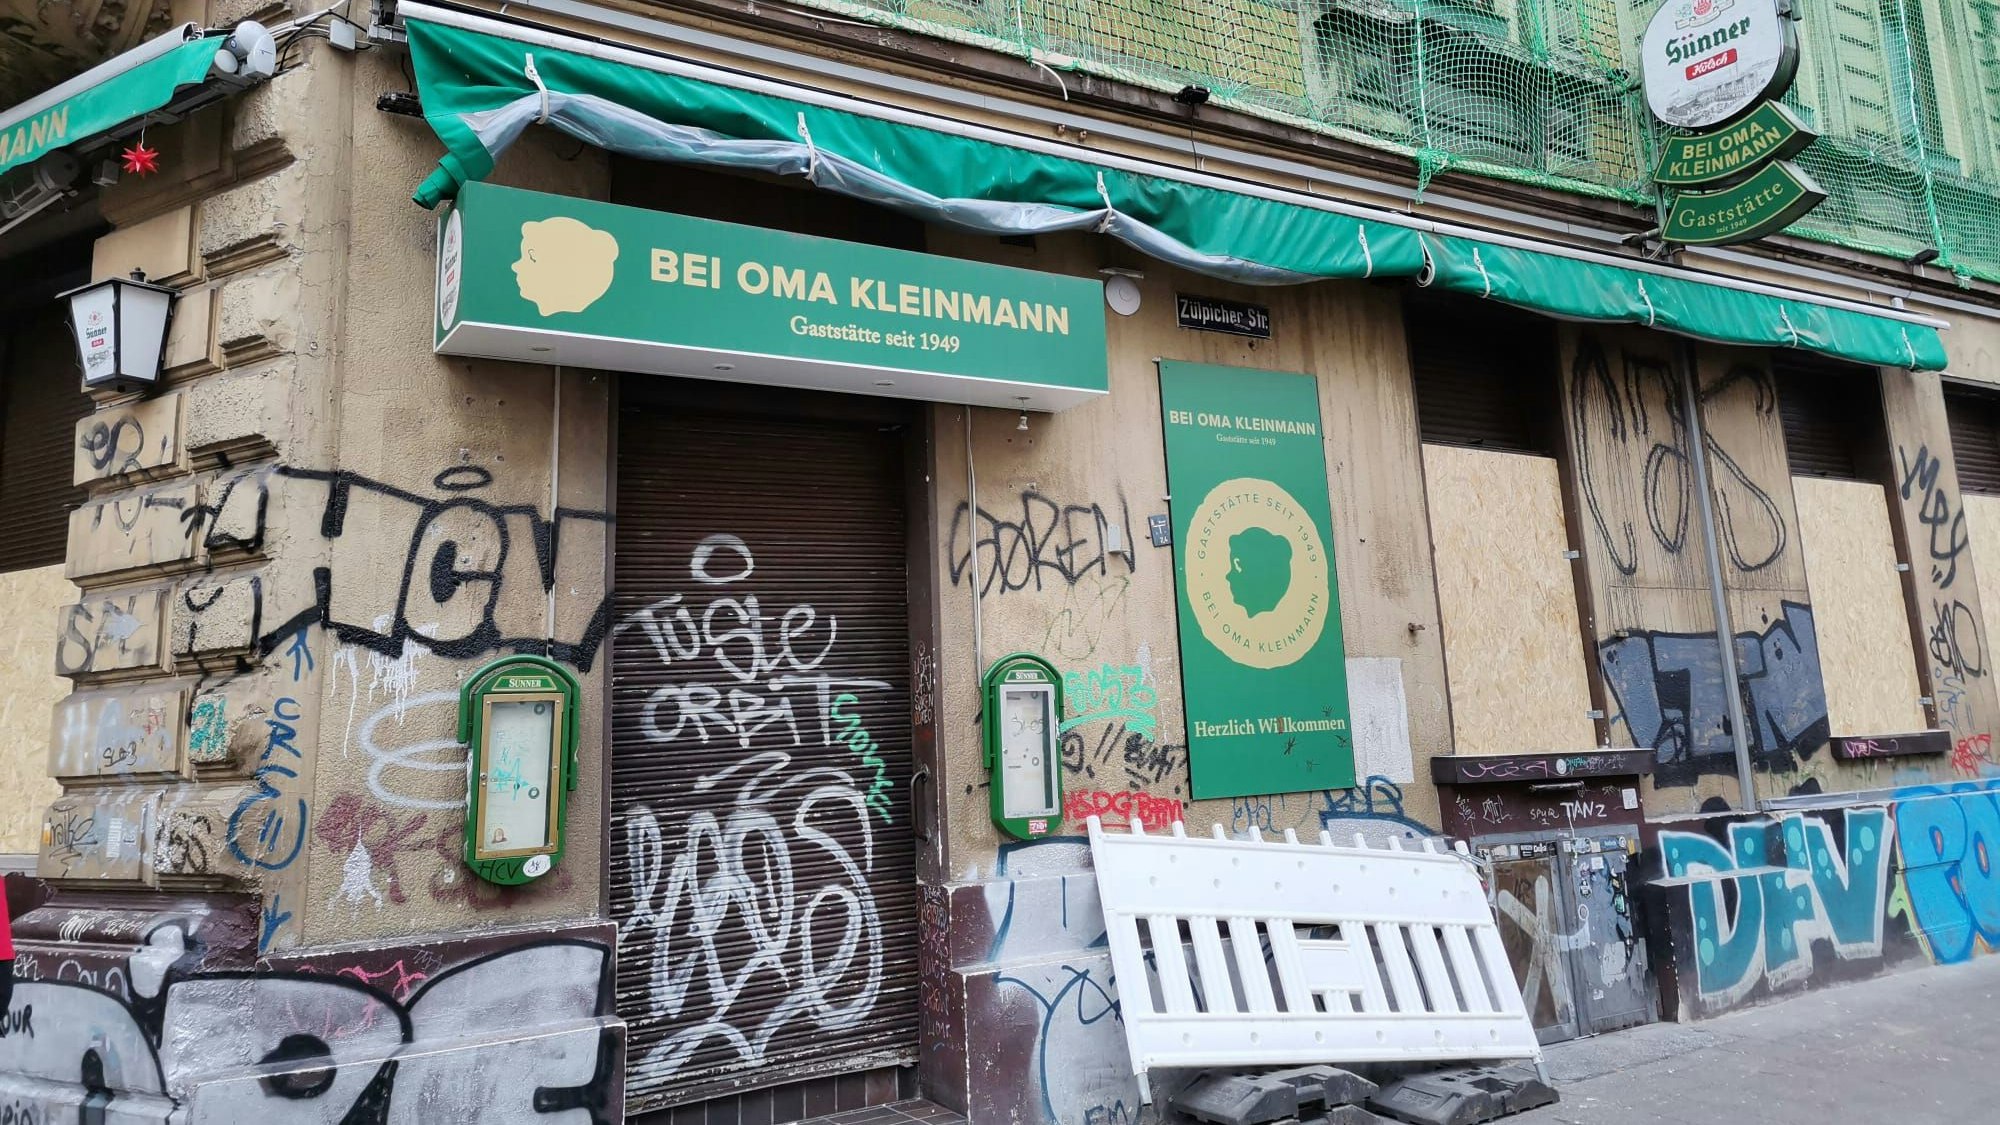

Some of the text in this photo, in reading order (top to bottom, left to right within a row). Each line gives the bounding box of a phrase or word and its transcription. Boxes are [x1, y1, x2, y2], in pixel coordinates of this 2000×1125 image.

[1665, 16, 1751, 67] Sünner
[1691, 52, 1729, 77] Kölsch
[1669, 126, 1782, 177] KLEINMANN
[1682, 120, 1764, 160] BEI OMA
[1678, 180, 1784, 229] Gaststätte
[1716, 217, 1748, 234] seit 1949
[650, 247, 1070, 336] BEI OMA KLEINMANN
[789, 314, 961, 354] Gaststätte seit 1949
[1179, 298, 1269, 331] Zülpicher Str.
[1169, 410, 1316, 436] BEI OMA KLEINMANN
[1216, 433, 1277, 446] Gaststätte seit 1949
[1198, 492, 1318, 562] GASTSTÄTTE SEIT 1949
[1202, 590, 1319, 654] BEI OMA KLEINMANN
[1194, 716, 1346, 737] Herzlich Willkommen
